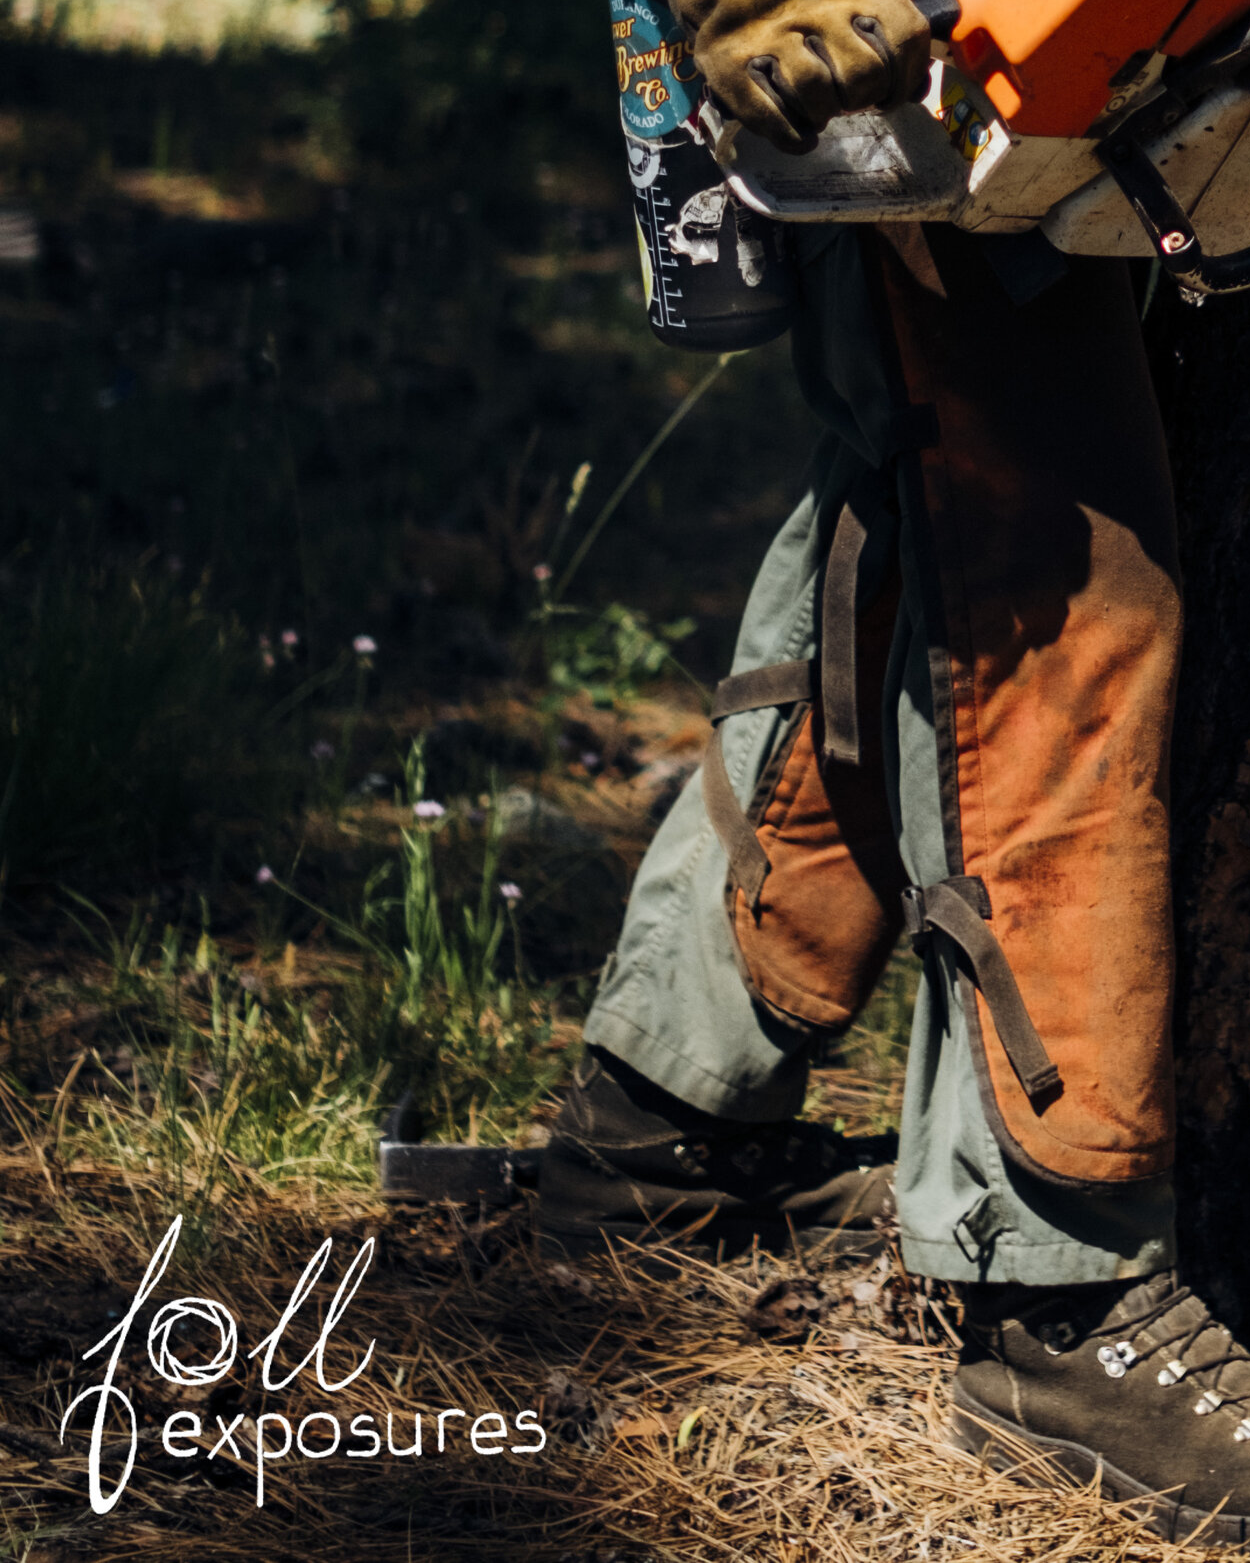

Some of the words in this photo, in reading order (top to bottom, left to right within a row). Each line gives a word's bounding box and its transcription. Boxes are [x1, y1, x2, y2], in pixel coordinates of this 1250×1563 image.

[616, 40, 700, 93] Brewing
[635, 78, 670, 112] Co.
[623, 105, 665, 128] LORADO
